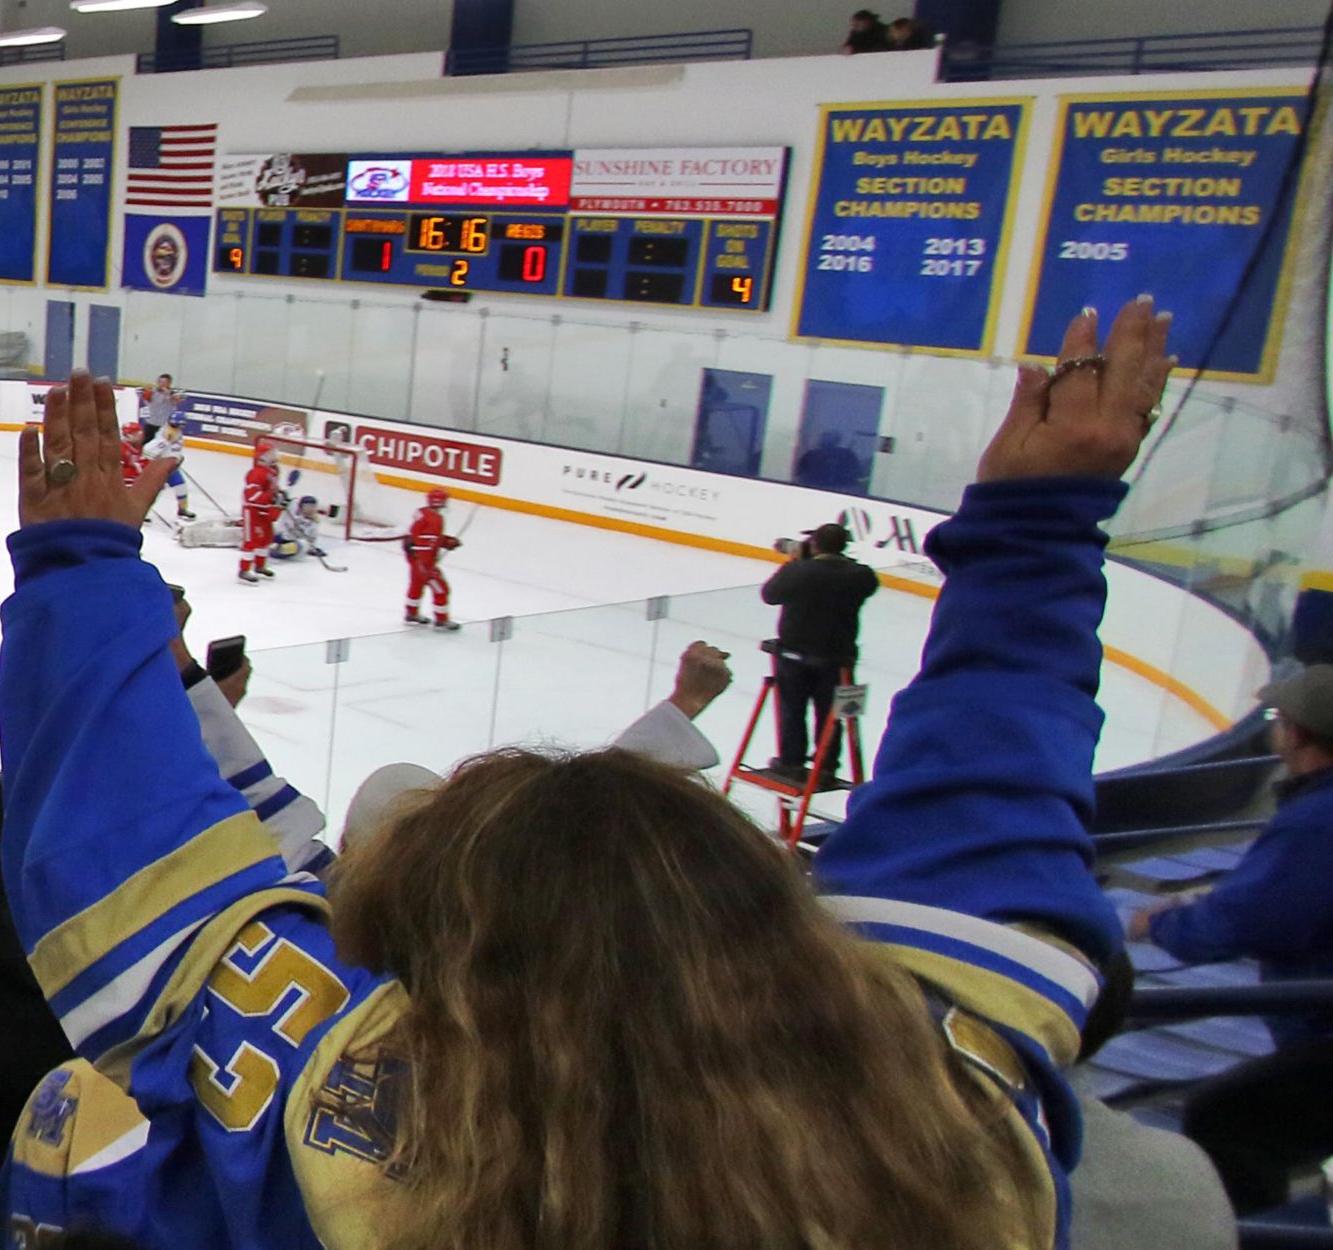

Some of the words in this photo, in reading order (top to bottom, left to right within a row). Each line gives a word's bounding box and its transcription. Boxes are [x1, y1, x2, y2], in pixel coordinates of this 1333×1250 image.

[831, 114, 1012, 143] WAYZATA
[1073, 106, 1302, 138] WAYZATA
[574, 158, 674, 177] SUNSHINE
[679, 158, 777, 176] FACTORY
[852, 151, 899, 168] Boys
[902, 151, 979, 168] Hockey
[1100, 148, 1157, 164] Girls
[1162, 147, 1257, 167] Hockey
[456, 164, 483, 178] USA
[511, 163, 545, 181] Boys
[421, 182, 468, 197] National
[468, 182, 550, 200] Championship
[855, 177, 967, 194] SECTION
[1102, 177, 1241, 197] SECTION
[578, 199, 646, 211] PLYMOUTH
[834, 201, 981, 220] CHAMPIONS
[1074, 203, 1261, 226] CHAMPIONS
[381, 241, 392, 271] 1
[820, 234, 876, 252] 2004
[923, 238, 986, 256] 2013
[1058, 240, 1129, 261] 2005
[229, 247, 243, 269] 9
[522, 245, 546, 282] 0
[816, 254, 873, 273] 2016
[919, 259, 983, 277] 2017
[451, 260, 469, 286] 2
[732, 276, 752, 303] 4
[359, 434, 496, 477] CHIPOTLE
[563, 465, 612, 483] PURE
[651, 482, 721, 501] HOCKEY
